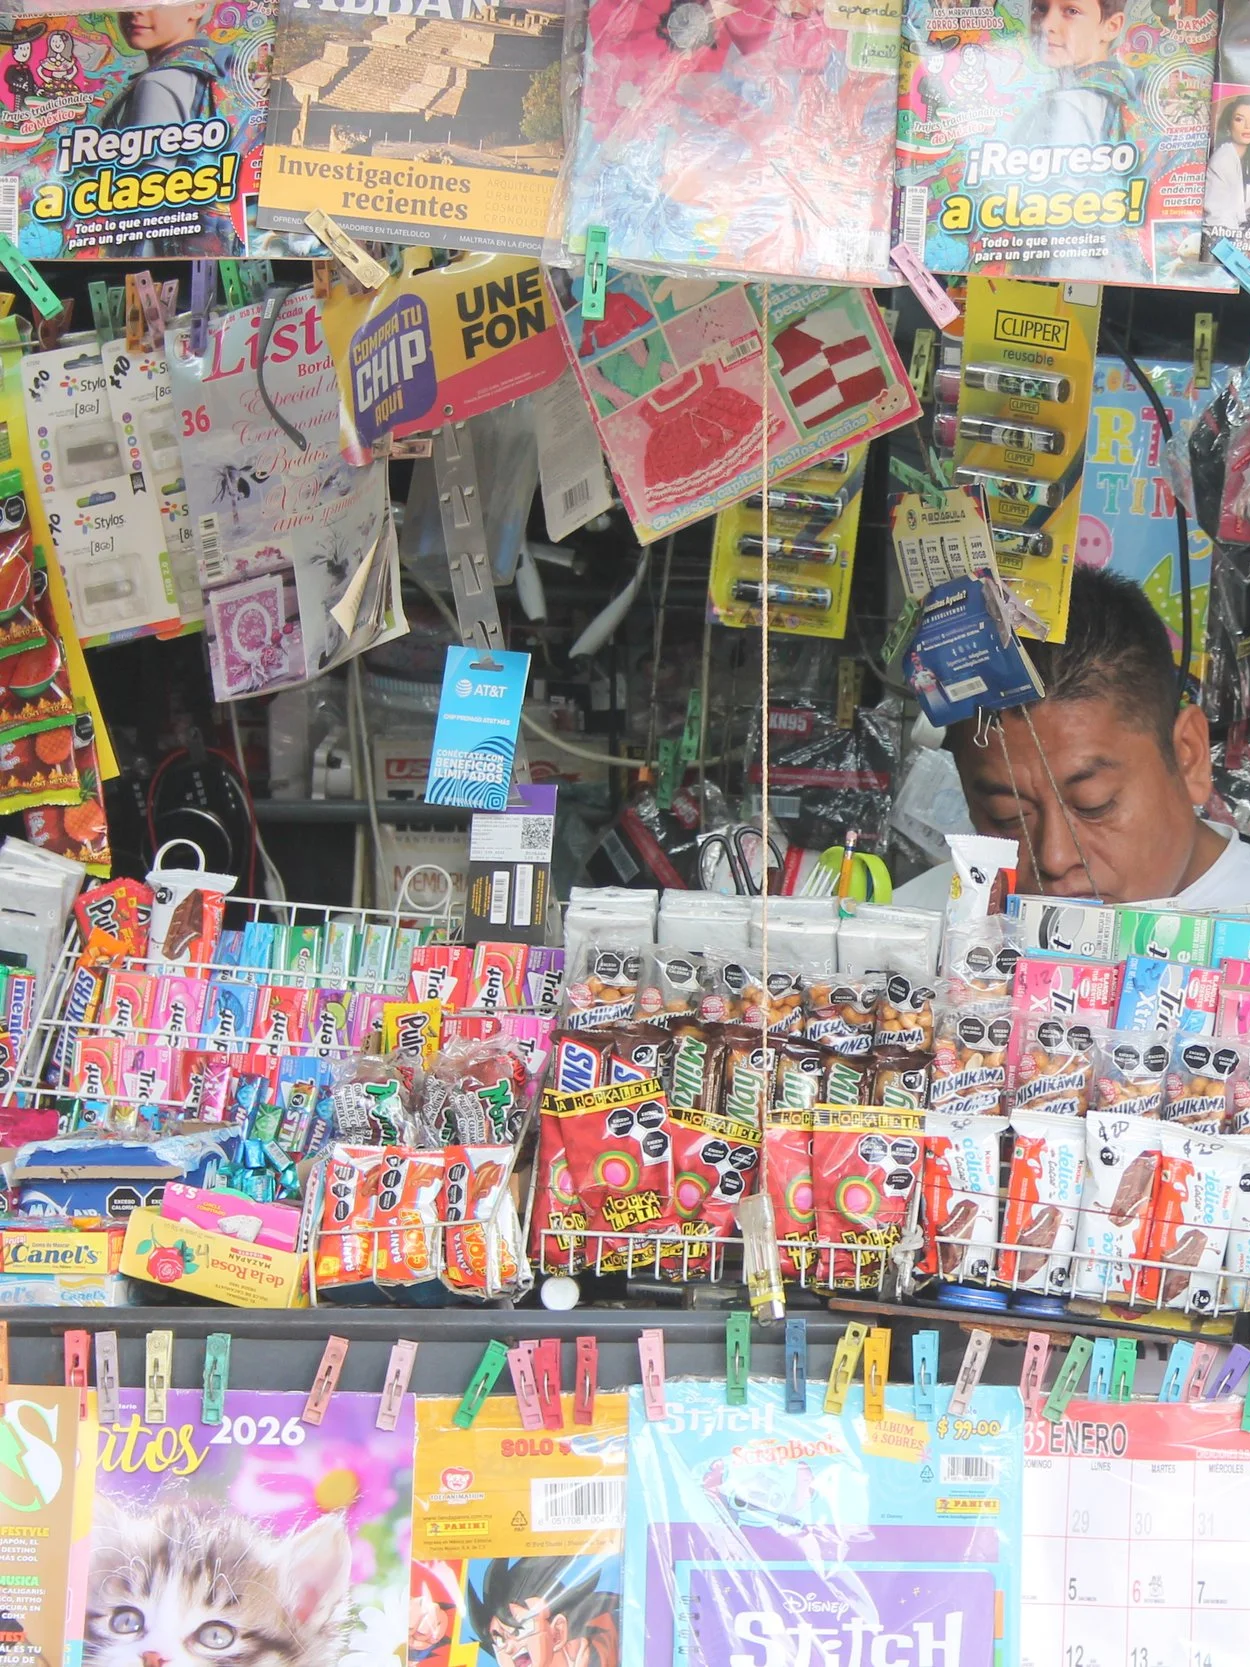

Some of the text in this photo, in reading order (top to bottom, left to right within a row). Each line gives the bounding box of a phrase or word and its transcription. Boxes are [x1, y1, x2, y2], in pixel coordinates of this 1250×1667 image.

[838, 3, 899, 16] aprende
[1176, 11, 1217, 29] DARWIN
[926, 18, 1004, 29] ZORROS OREJUDOS
[58, 121, 225, 172] ¡Regreso
[279, 155, 471, 193] Investigaciones
[34, 155, 236, 218] a clases!
[342, 192, 468, 220] recientes
[75, 212, 199, 234] Todo lo que necesitas
[69, 225, 201, 250] para un gran comienzo
[459, 236, 495, 246] MALTRATA
[496, 239, 506, 247] EN
[456, 266, 542, 322] UNE
[352, 304, 422, 366] COMPRA TU
[462, 302, 546, 360] FON
[1001, 317, 1064, 344] CLIPPER
[1003, 348, 1054, 367] reusable
[356, 330, 427, 413] CHIP
[375, 384, 403, 427] AQUÍ
[1012, 401, 1037, 411] CLIPPER
[181, 405, 210, 437] 36
[1006, 454, 1033, 464] CLIPPER
[1002, 504, 1027, 515] CLIPPER
[473, 685, 507, 699] AT&T
[769, 712, 807, 731] KN95
[435, 757, 503, 773] BENEFICIOS
[437, 749, 504, 762] CONÉCTATE CON
[434, 768, 503, 784] ILIMITADOS
[575, 1081, 662, 1107] ROCKALETA
[932, 1067, 1005, 1099] NISHIKAWA
[1016, 1073, 1084, 1105] NISHIKAWA
[829, 1114, 920, 1130] ROCKALETA
[11, 1246, 101, 1264] Canel's
[456, 1233, 473, 1275] RANITA
[212, 1259, 284, 1288] de la Rosa
[210, 1416, 305, 1445] 2026
[875, 1422, 914, 1435] ALBUM
[953, 1419, 1001, 1440] 99.00
[1050, 1421, 1127, 1457] ENERO
[501, 1439, 553, 1457] SOLO
[882, 1434, 923, 1450] SOBRES
[1090, 1462, 1111, 1472] LUNES
[1151, 1464, 1175, 1474] MARTES
[1209, 1463, 1244, 1474] MIÉRCOLES
[1068, 1578, 1077, 1600] 5
[1133, 1580, 1141, 1603] 6
[1197, 1582, 1205, 1605] 7
